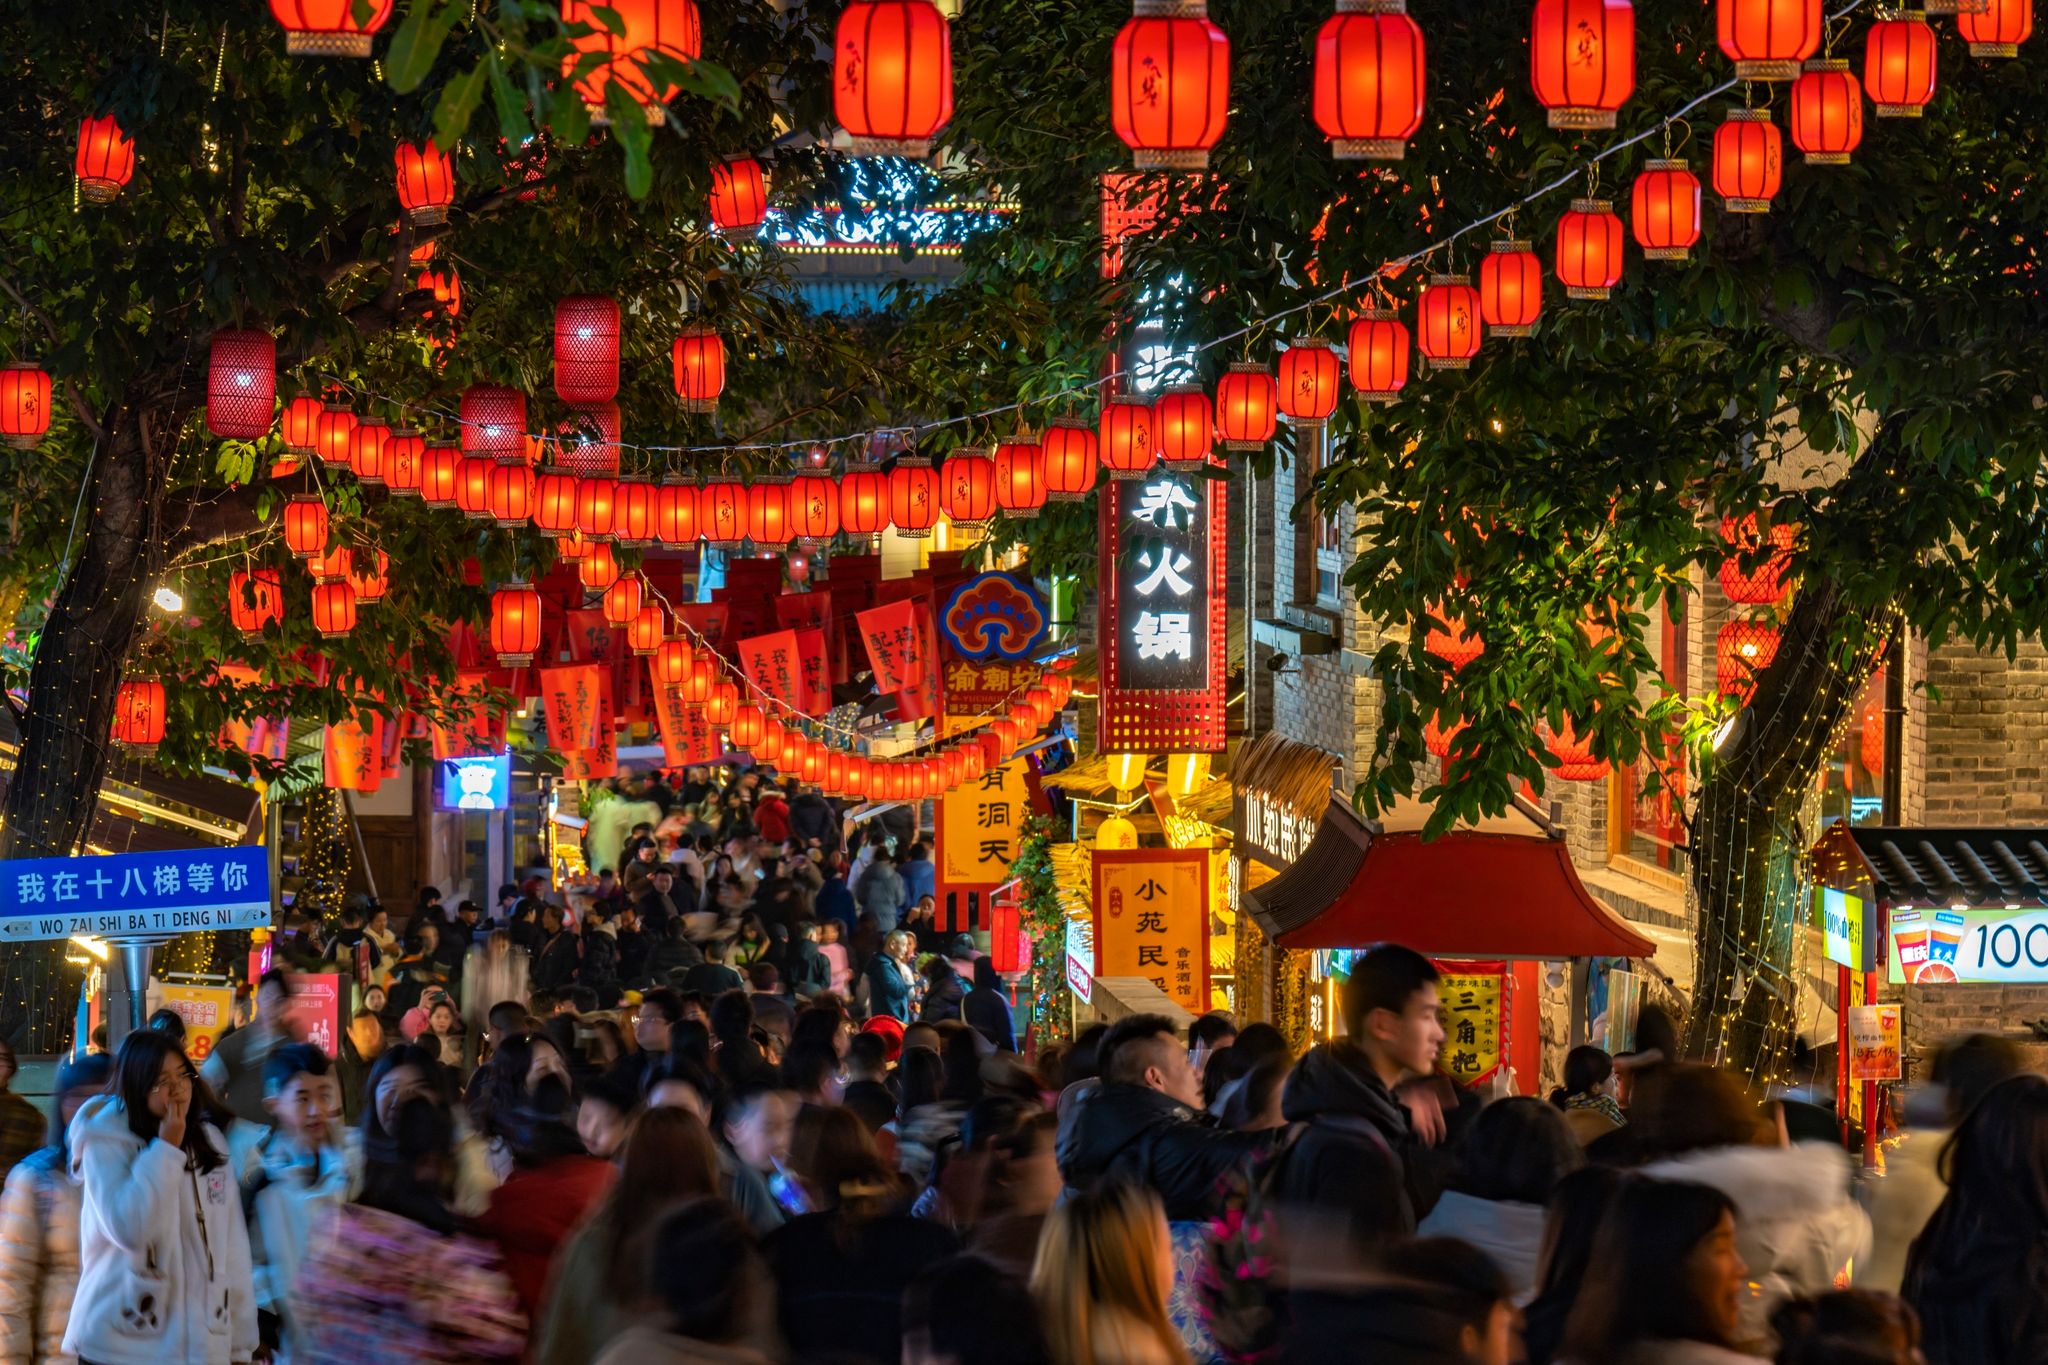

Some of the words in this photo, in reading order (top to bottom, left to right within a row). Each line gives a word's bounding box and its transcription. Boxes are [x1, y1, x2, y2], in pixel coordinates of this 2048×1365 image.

[978, 767, 1011, 865] 有洞天
[18, 862, 249, 903] 我在十八梯等你
[40, 919, 63, 934] WO
[70, 917, 92, 932] ZAI
[100, 916, 121, 931] SHI
[129, 915, 146, 929] BA
[153, 914, 165, 927] TI
[173, 911, 209, 926] DENG
[217, 909, 231, 923] NI
[1977, 923, 2048, 968] 100
[1175, 947, 1191, 995] 音乐酒馆
[1451, 991, 1481, 1074] 三角粑
